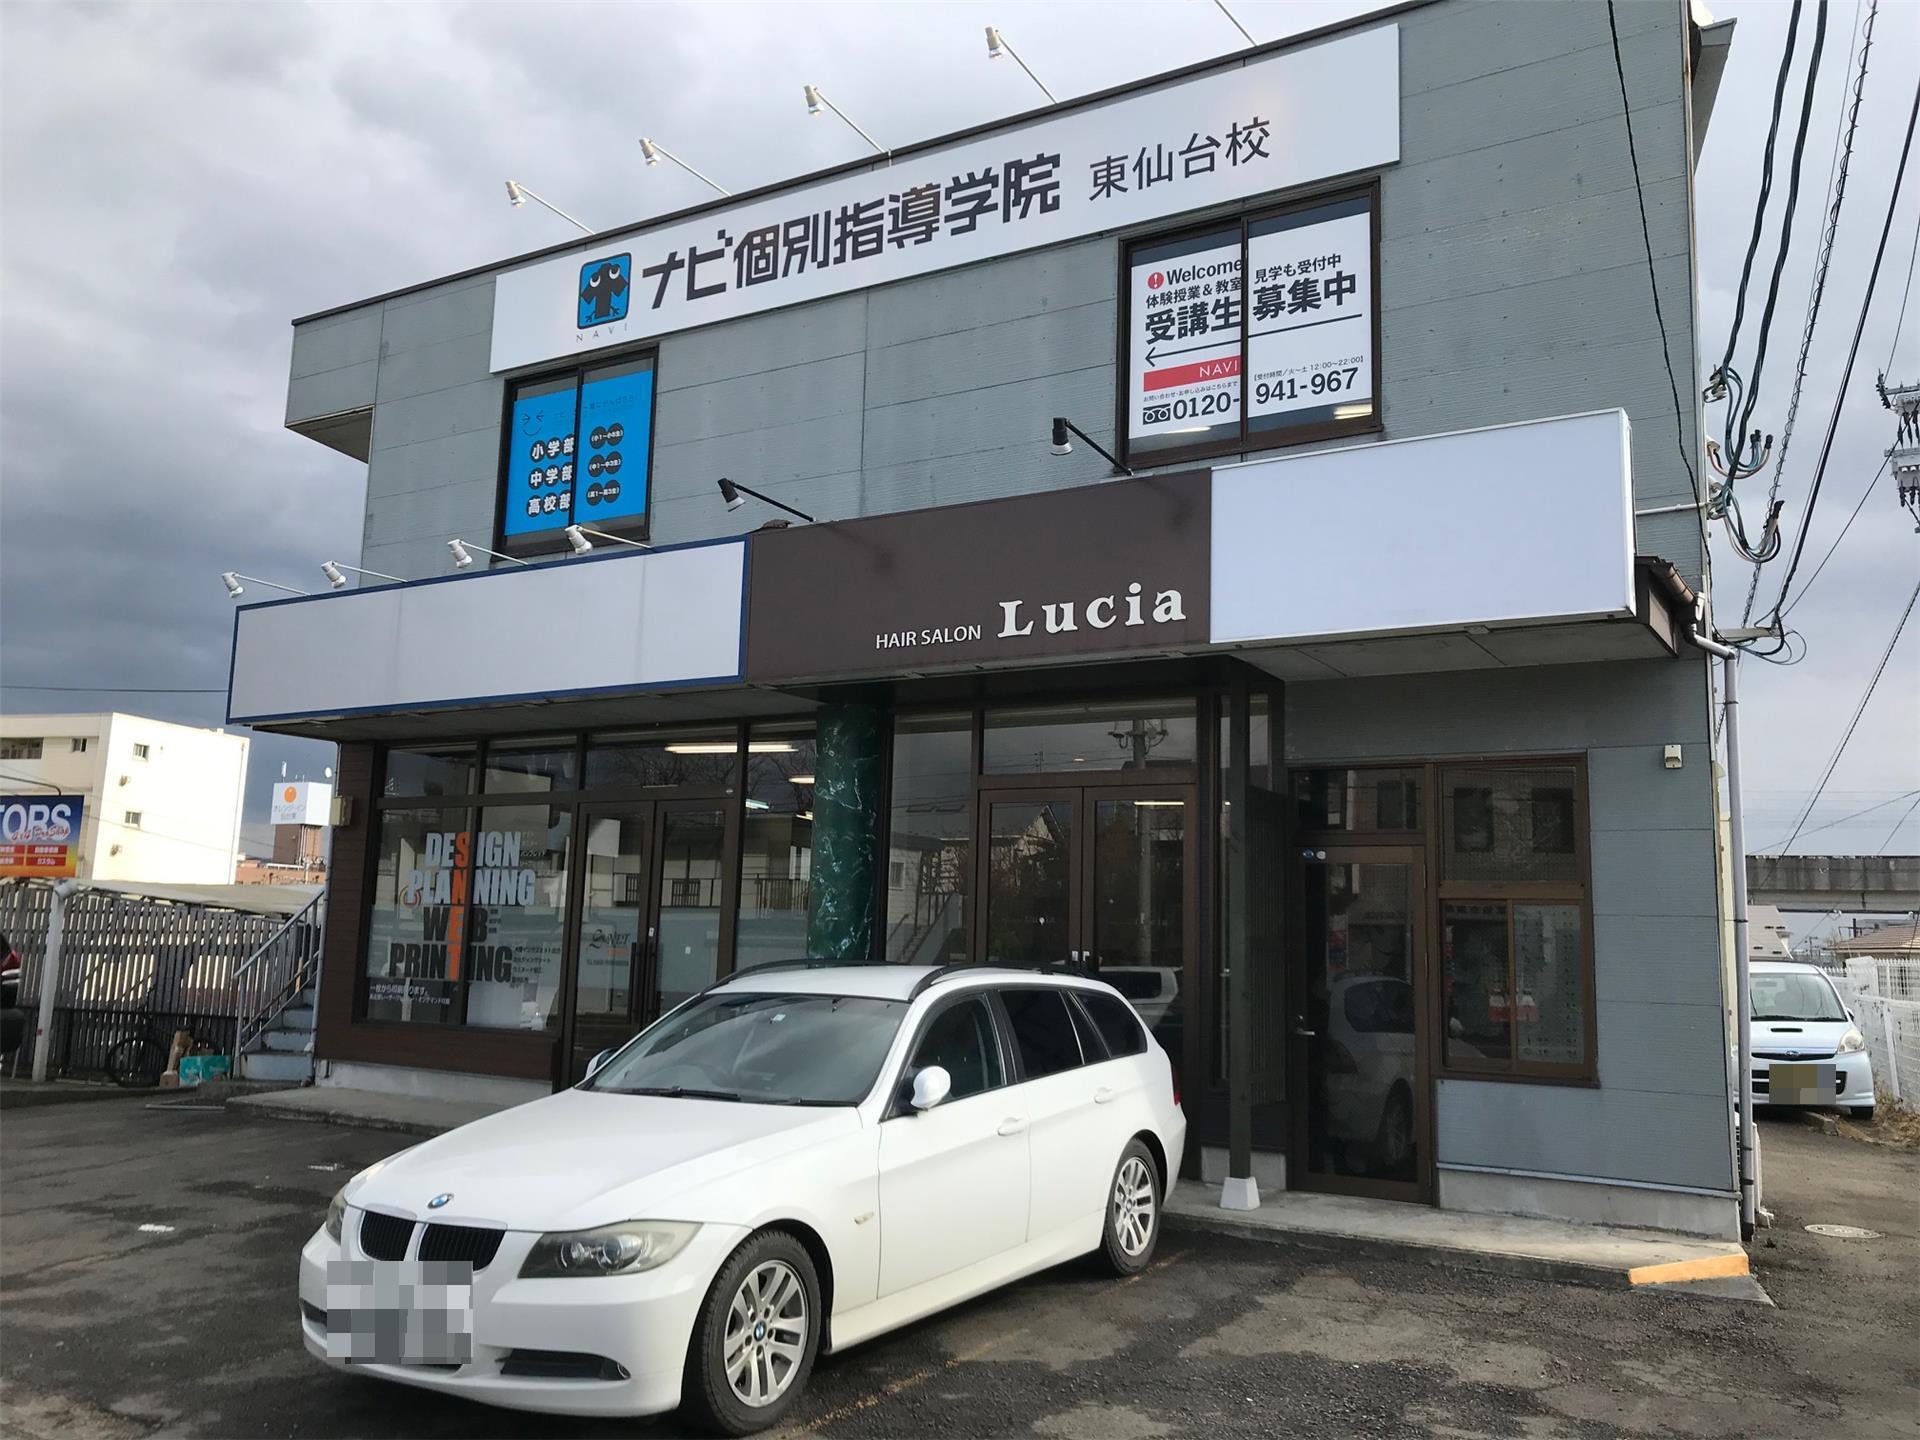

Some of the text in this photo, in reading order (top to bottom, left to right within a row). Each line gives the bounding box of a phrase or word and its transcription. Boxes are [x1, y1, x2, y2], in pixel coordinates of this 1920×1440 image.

[642, 116, 1270, 310] ナビ個別指導学院 東仙台校
[1166, 258, 1242, 286] Welcome
[1145, 270, 1356, 345] 受講生 募集中
[575, 322, 628, 344] NAVI
[1199, 359, 1238, 378] NAVI
[531, 437, 575, 460] 小学部
[530, 465, 573, 487] 中学部
[527, 493, 571, 515] 高校部
[875, 582, 1187, 650] HAIR SALON Lucia
[0, 803, 71, 841] ORS
[425, 831, 521, 868] DESIGN
[407, 868, 536, 905] PLANNING
[423, 907, 488, 943] WEB
[389, 943, 512, 982] PRINTING
